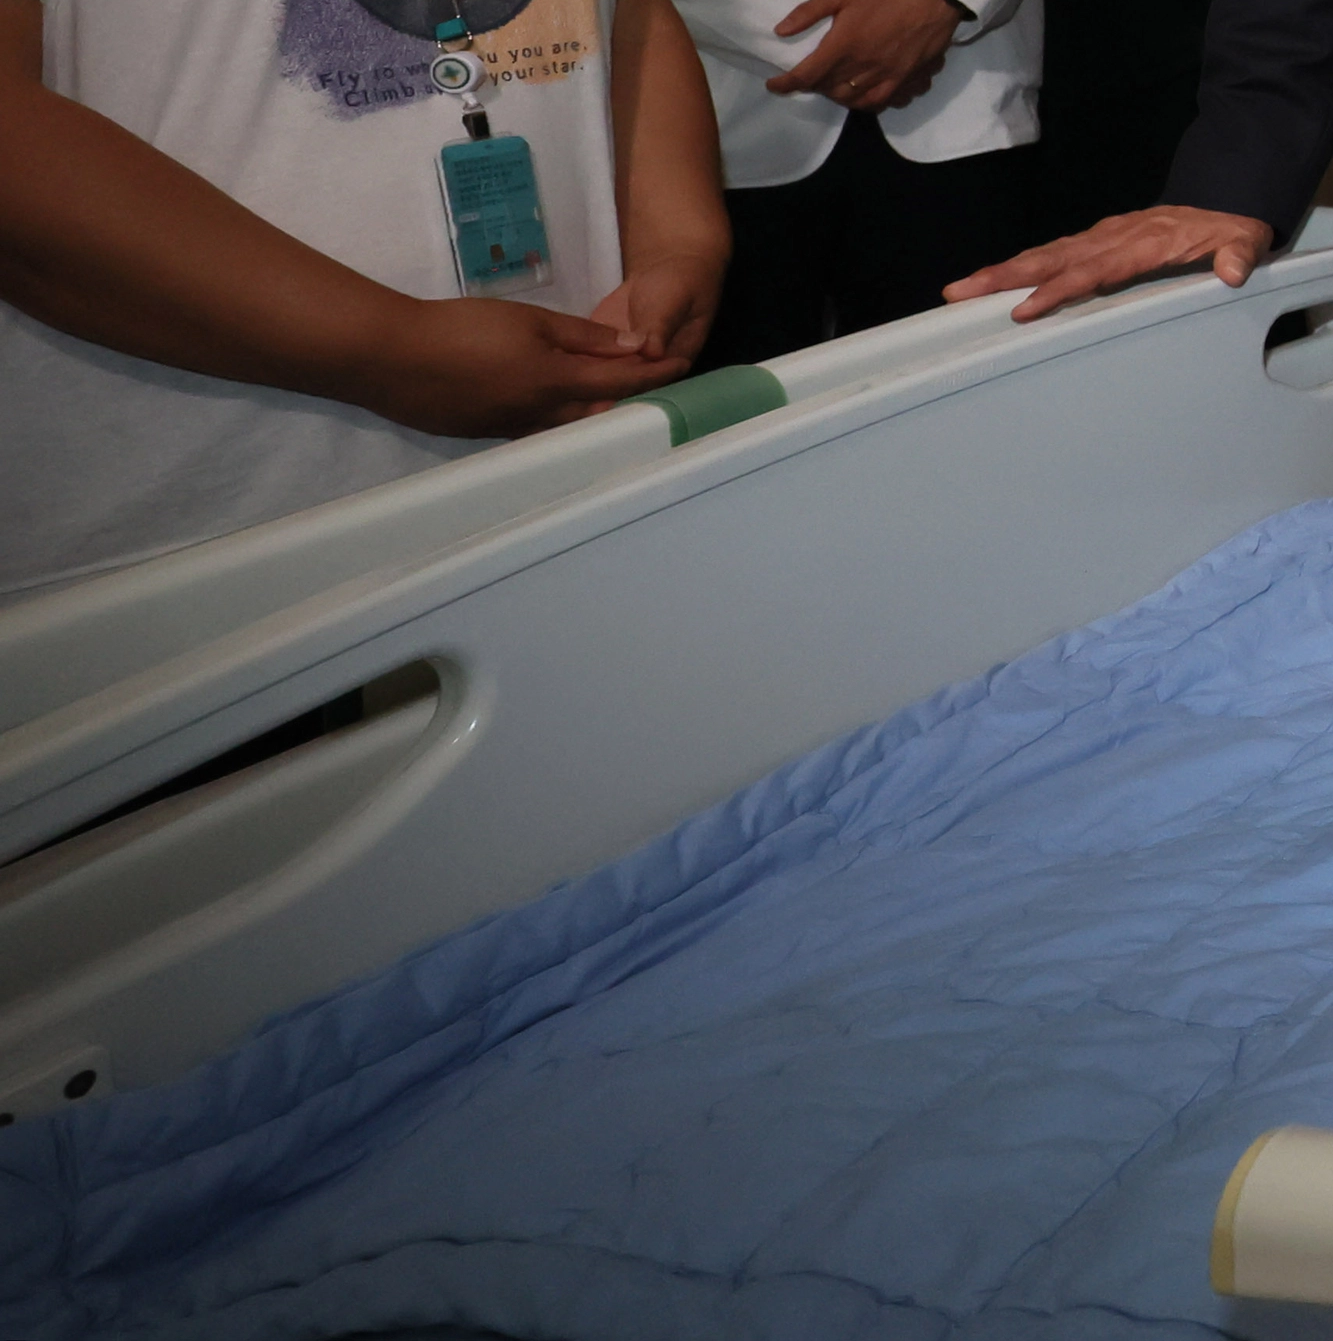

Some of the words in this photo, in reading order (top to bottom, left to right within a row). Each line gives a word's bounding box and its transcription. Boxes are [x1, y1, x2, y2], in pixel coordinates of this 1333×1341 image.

[318, 70, 361, 91] Fly
[508, 46, 543, 64] you
[344, 82, 415, 107] Climb
[489, 67, 534, 86] your
